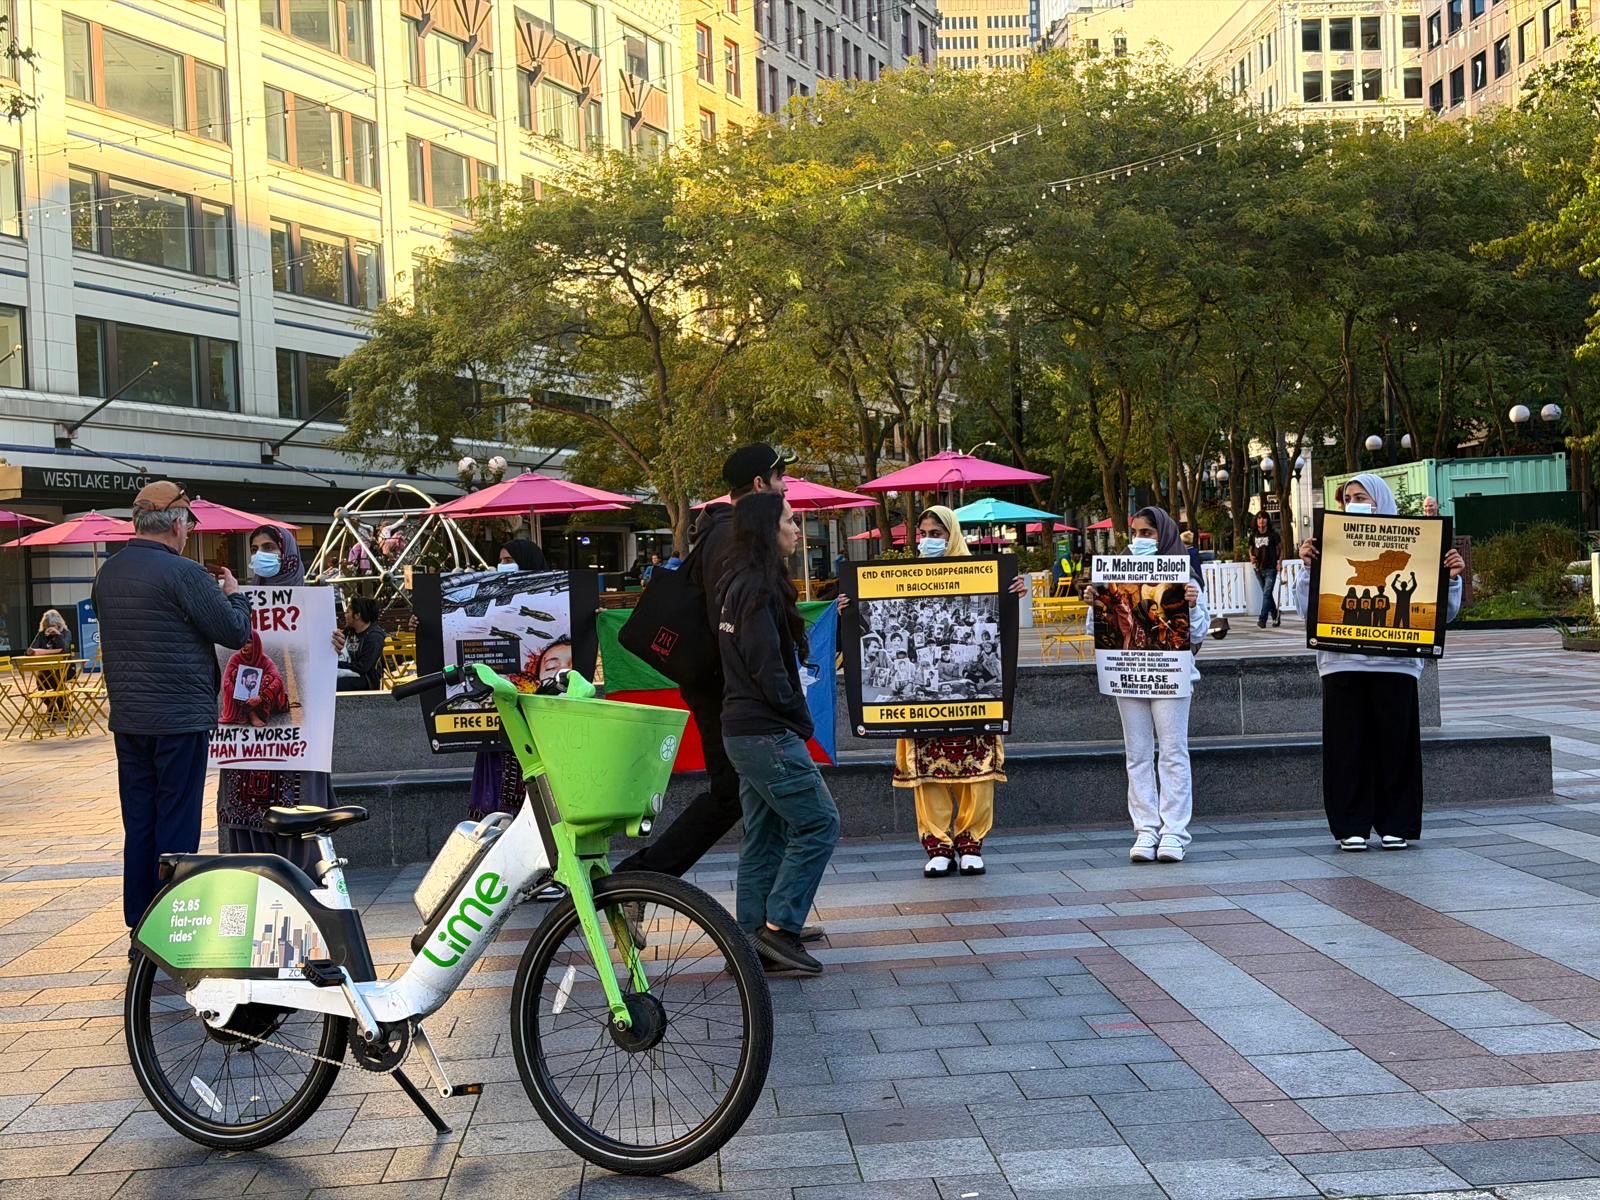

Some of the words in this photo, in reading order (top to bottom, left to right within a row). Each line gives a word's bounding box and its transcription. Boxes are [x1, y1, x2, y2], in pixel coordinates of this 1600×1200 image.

[42, 472, 110, 488] WESTLAKE
[114, 476, 151, 490] PLACE
[1344, 522, 1376, 533] UNITED
[1380, 525, 1420, 536] NATIONS
[1365, 534, 1416, 543] BALOCHISTAN'S
[862, 571, 878, 579] END
[881, 569, 923, 579] ENFORCED
[926, 565, 993, 577] DISAPPEARANCES
[1096, 558, 1109, 572] Dr.
[1112, 558, 1154, 574] Mahrang
[1157, 558, 1186, 572] Baloch
[896, 584, 904, 592] IN
[907, 582, 960, 592] BALOCHISTAN
[272, 589, 292, 605] MY
[1331, 626, 1352, 636] FREE
[1356, 628, 1420, 640] BALOCHISTAN
[1120, 674, 1168, 683] RELEASE
[1122, 682, 1152, 690] Mahrang
[880, 708, 906, 720] FREE
[910, 705, 986, 719] BALOCHISTAN
[453, 716, 481, 729] FREE
[208, 728, 249, 741] WHAT'S
[254, 727, 300, 741] WORSE
[208, 744, 237, 758] HAN
[242, 741, 307, 757] WAITING?
[170, 915, 213, 927] flat-rate
[422, 872, 508, 968] Lime
[289, 969, 302, 977] ZC
